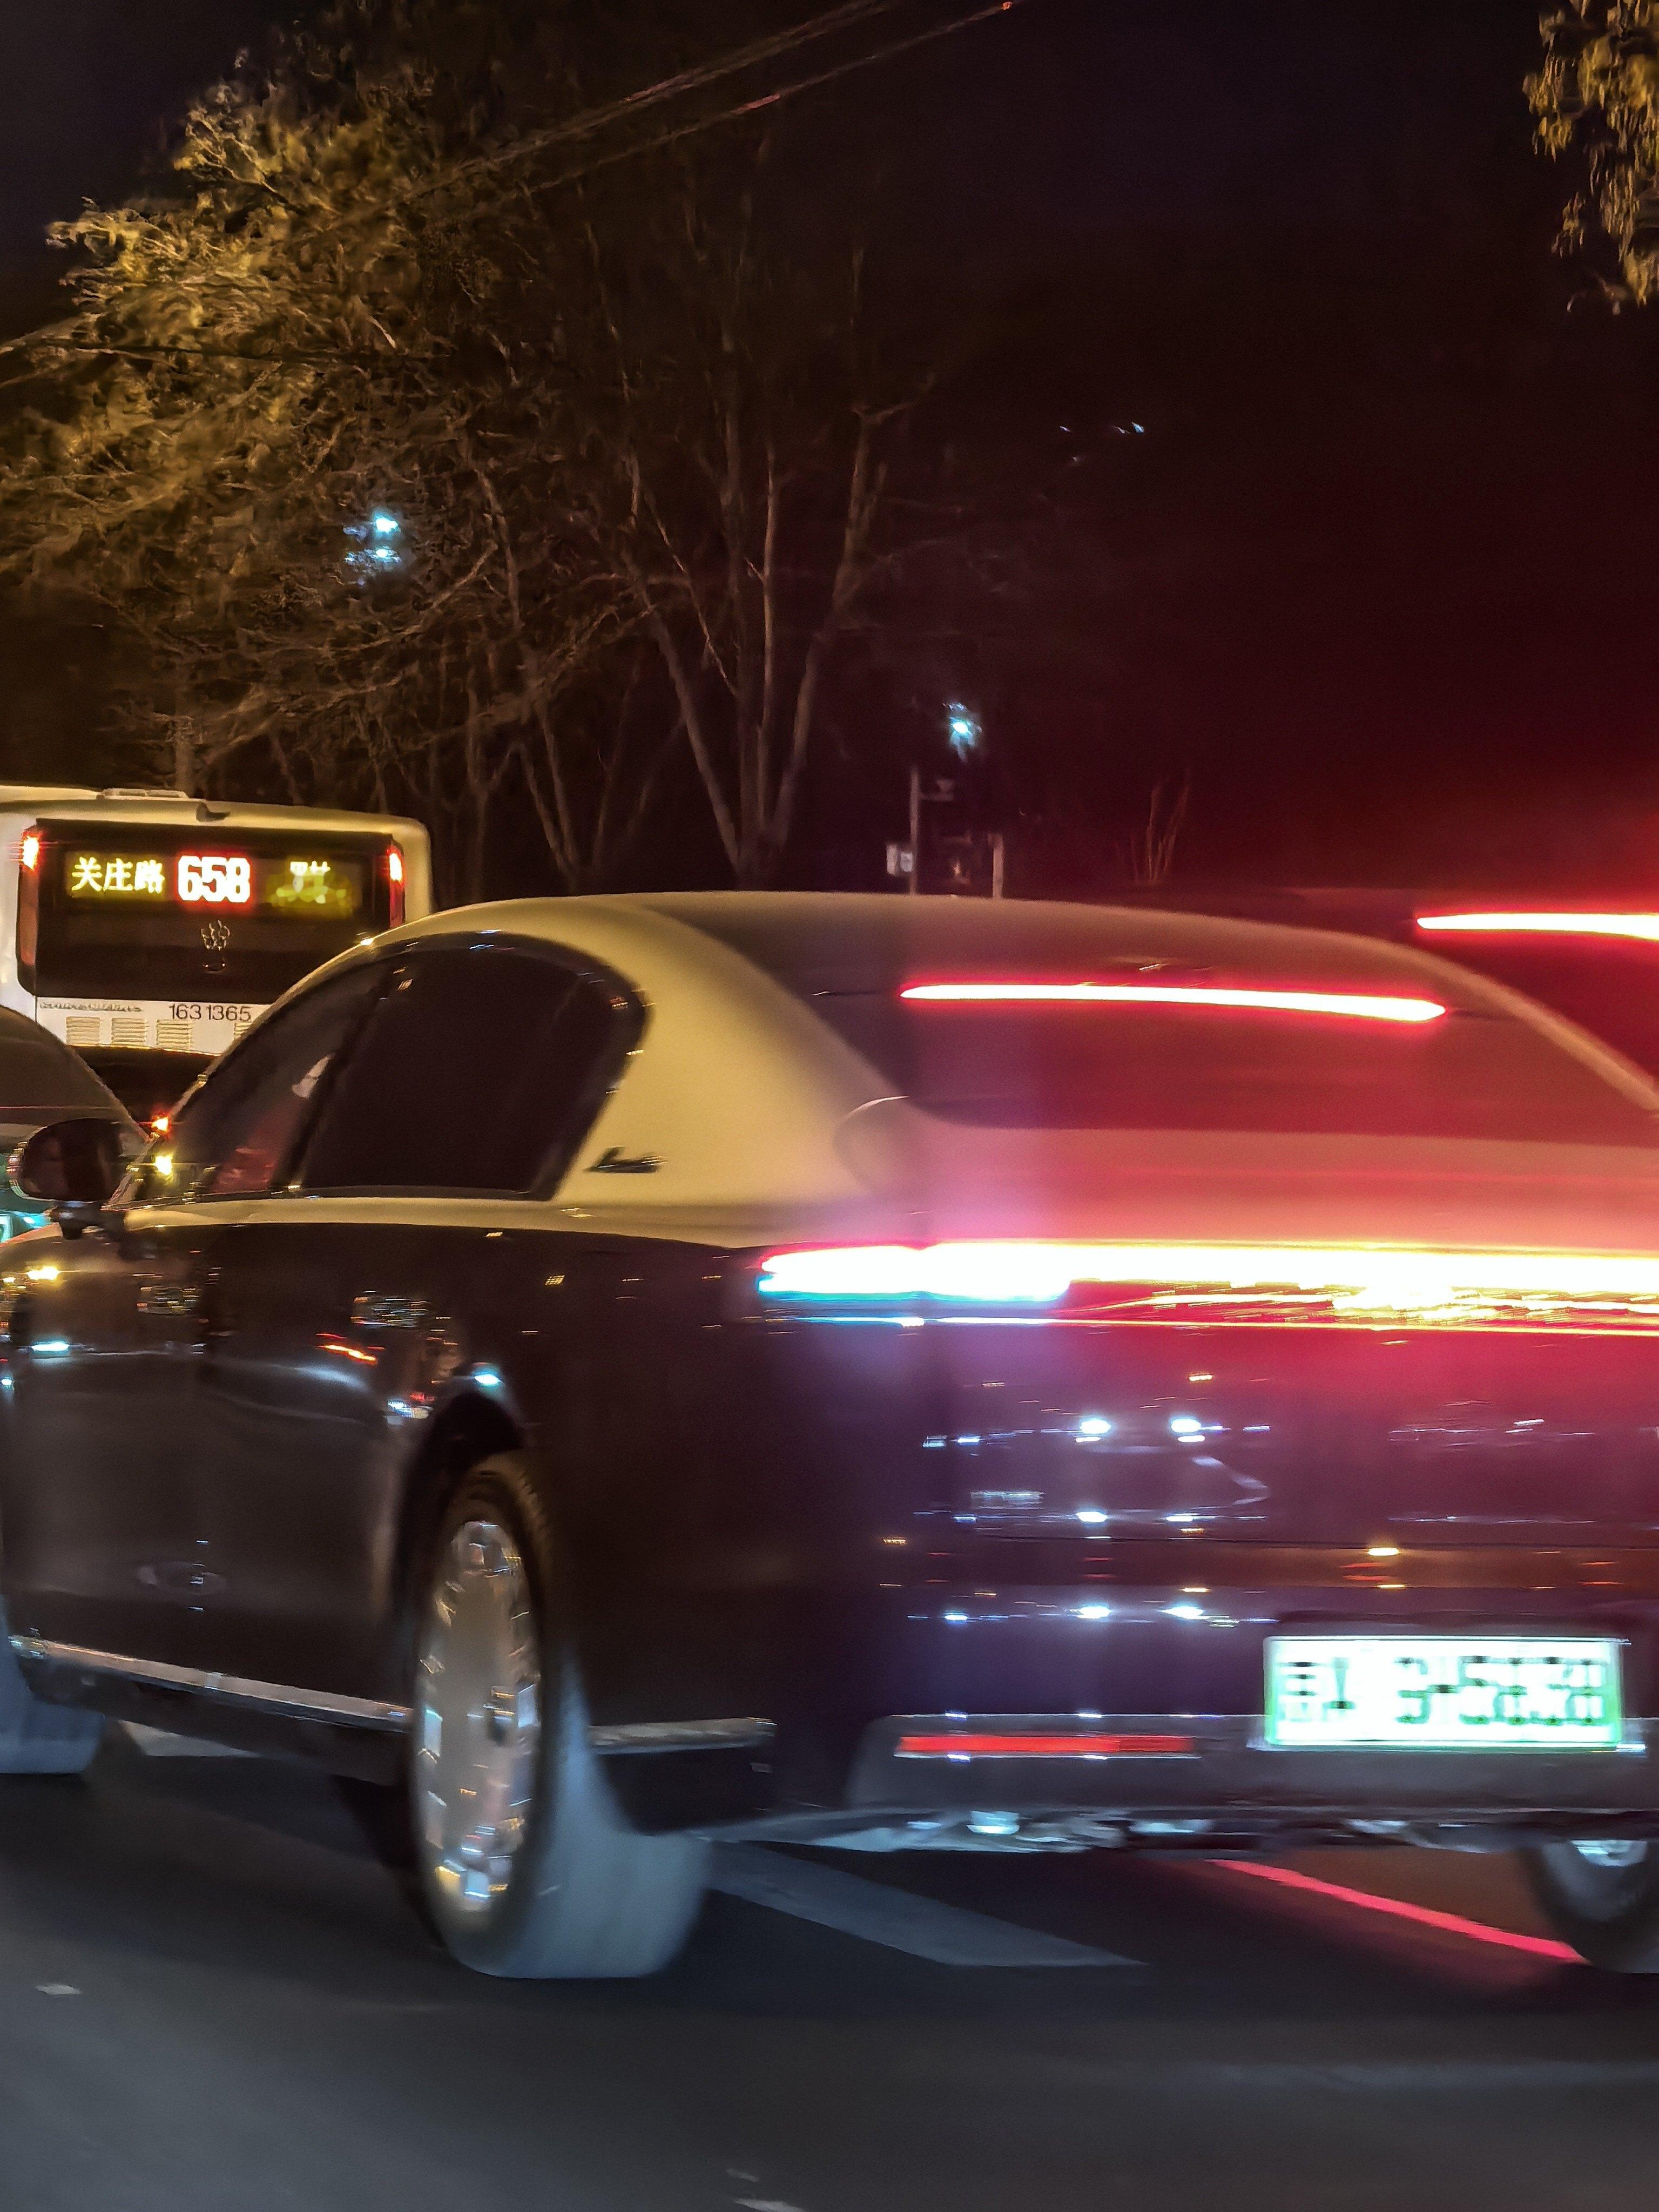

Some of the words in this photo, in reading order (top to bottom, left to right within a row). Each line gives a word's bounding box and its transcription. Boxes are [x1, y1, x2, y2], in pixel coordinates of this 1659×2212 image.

[71, 857, 165, 894] 关庄路
[178, 855, 251, 903] 658
